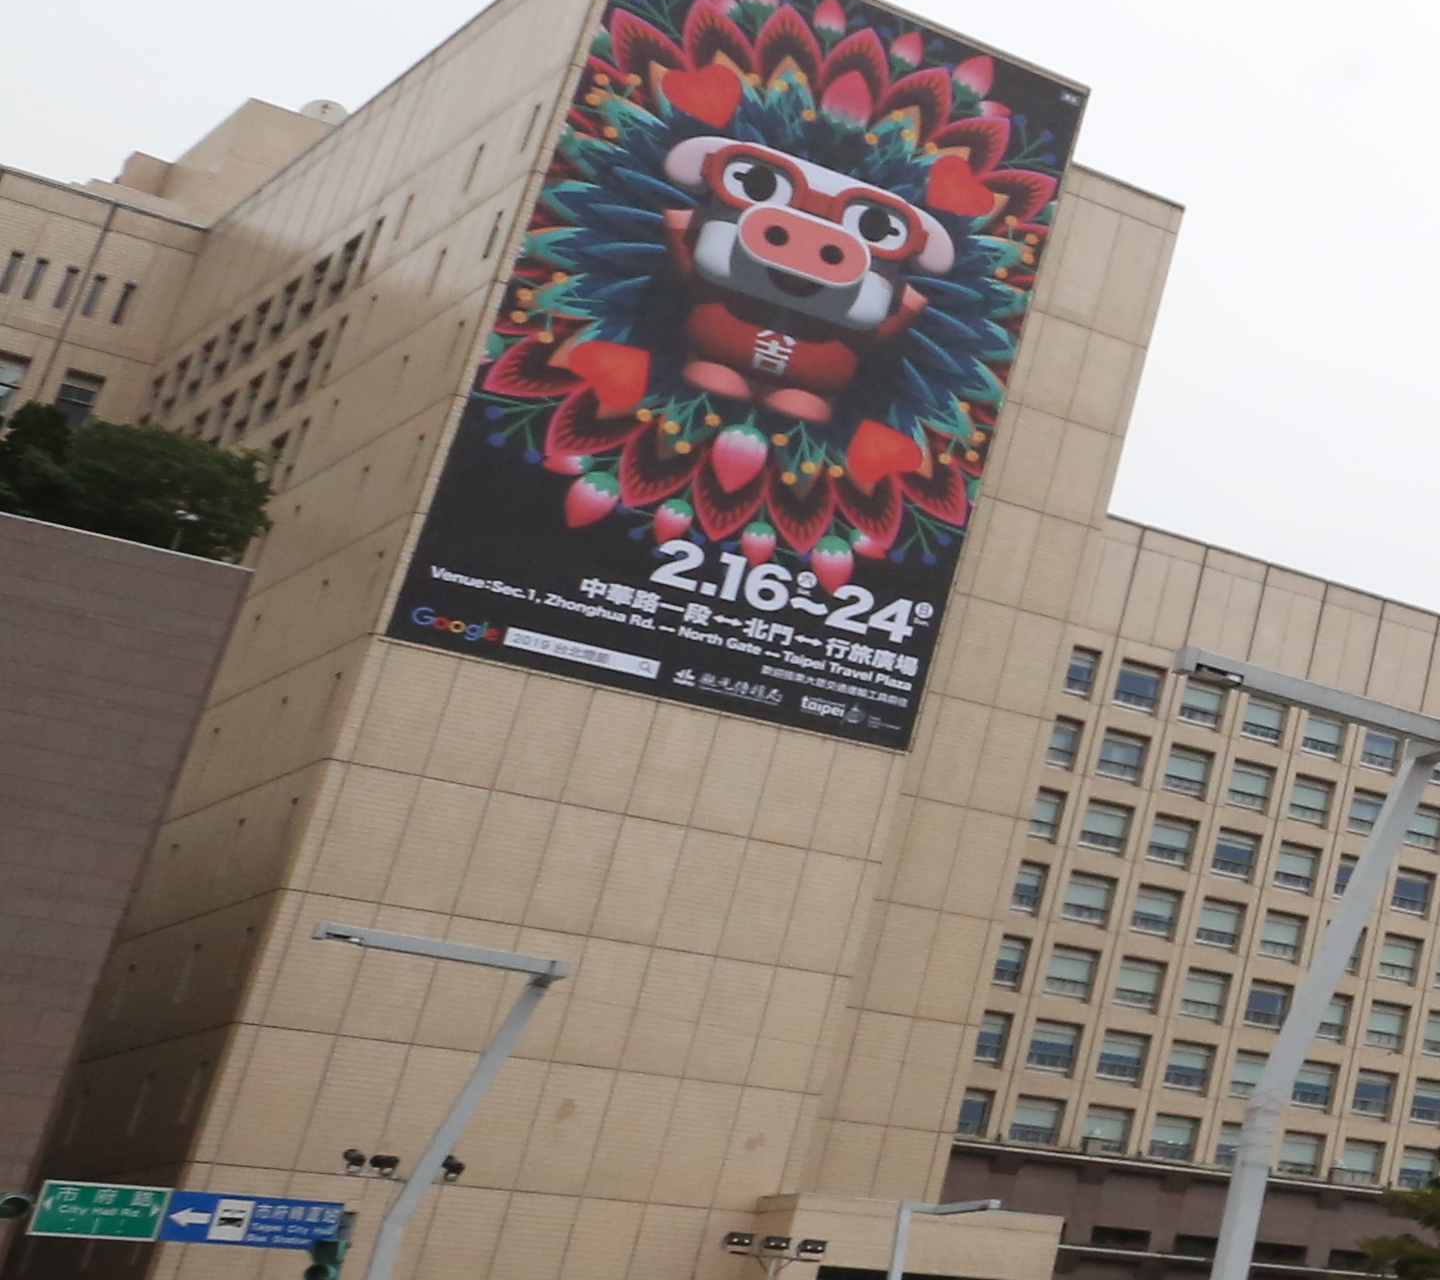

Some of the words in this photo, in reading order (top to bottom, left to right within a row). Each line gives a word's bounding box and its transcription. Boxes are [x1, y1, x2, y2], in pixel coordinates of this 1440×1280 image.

[411, 606, 498, 641] Google
[579, 577, 712, 625] 中華路一段
[743, 617, 795, 647] 北門
[825, 637, 919, 677] 行旅廣場
[512, 632, 549, 651] 2019
[543, 592, 627, 623] Zhonghua
[628, 613, 656, 631] Rd.
[677, 625, 724, 647] North
[725, 637, 763, 656] Gate
[782, 650, 826, 671] Taipei
[829, 661, 873, 681] Travel
[875, 671, 913, 692] Plaza
[54, 1186, 155, 1207] 市府路
[59, 1204, 89, 1216] City
